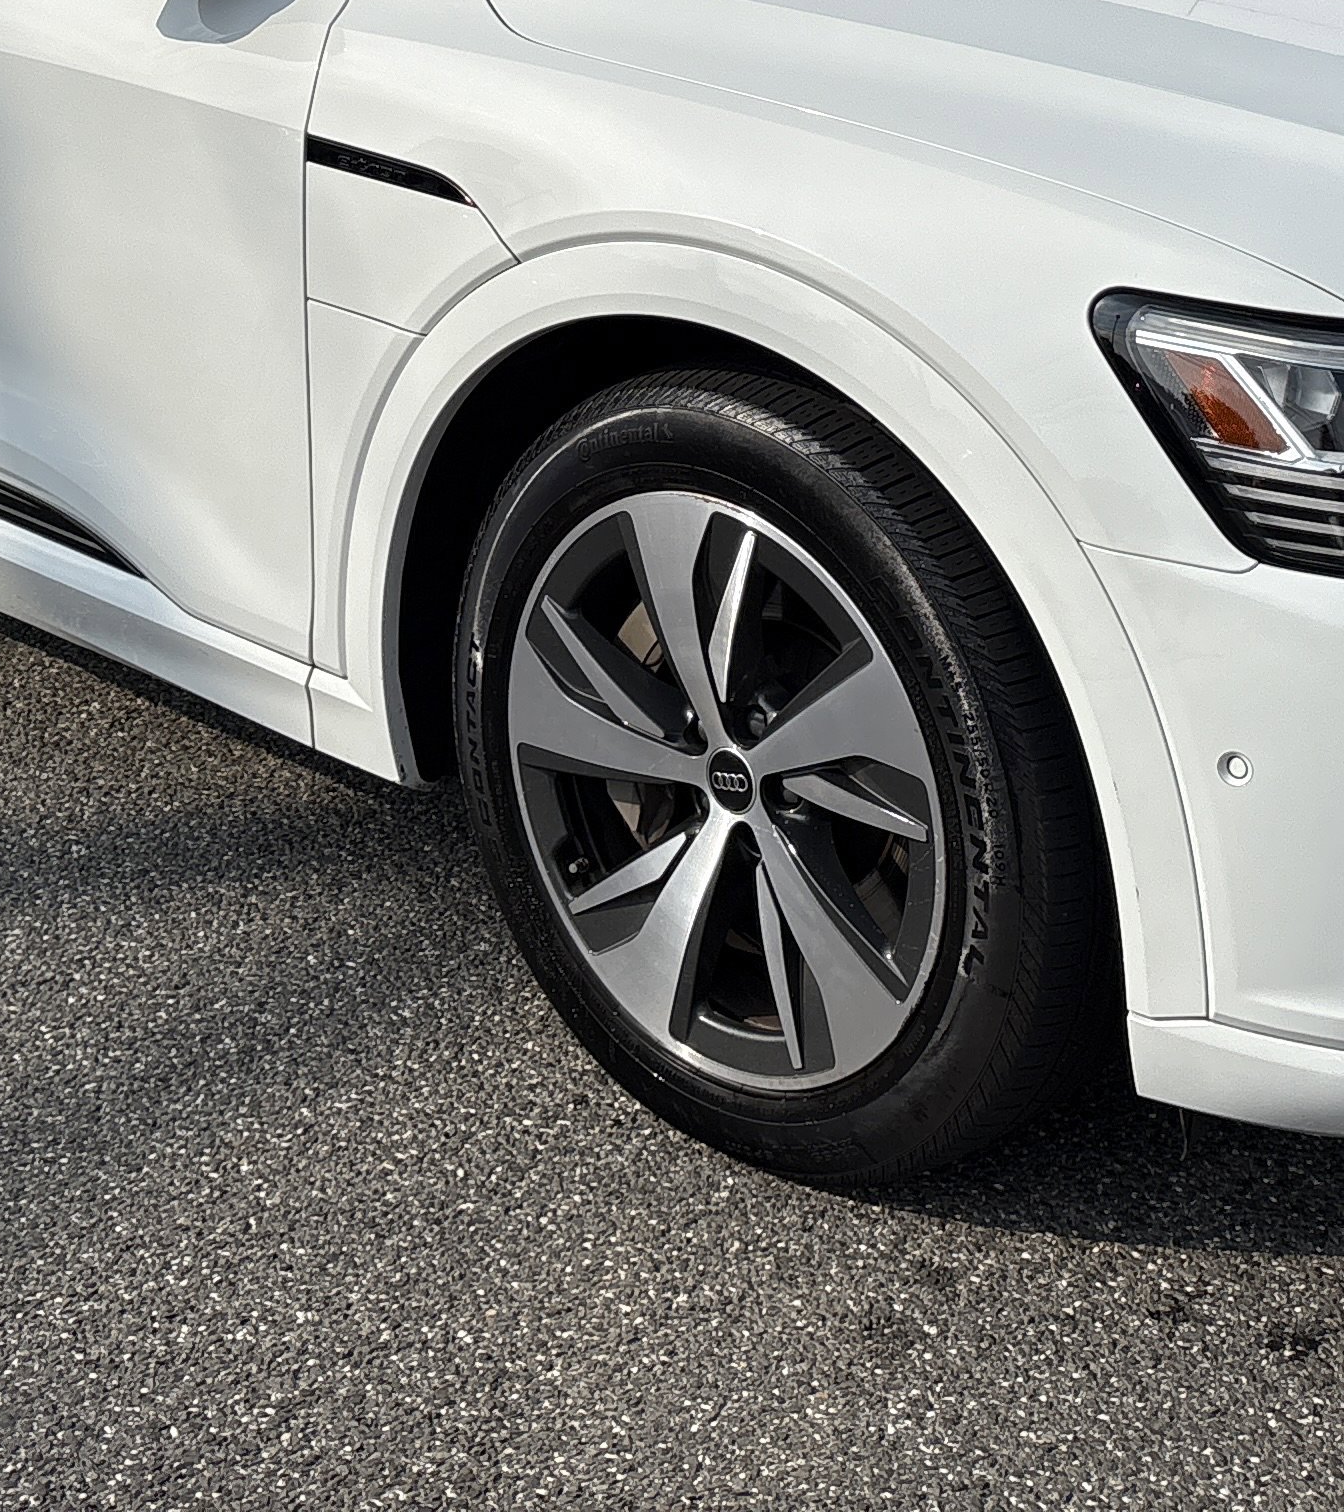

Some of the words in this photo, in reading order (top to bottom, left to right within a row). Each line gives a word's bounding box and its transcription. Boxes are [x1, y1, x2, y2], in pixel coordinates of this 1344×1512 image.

[576, 422, 659, 463] Continental
[466, 632, 492, 828] CONTACT
[866, 575, 990, 979] CONTINENTAL
